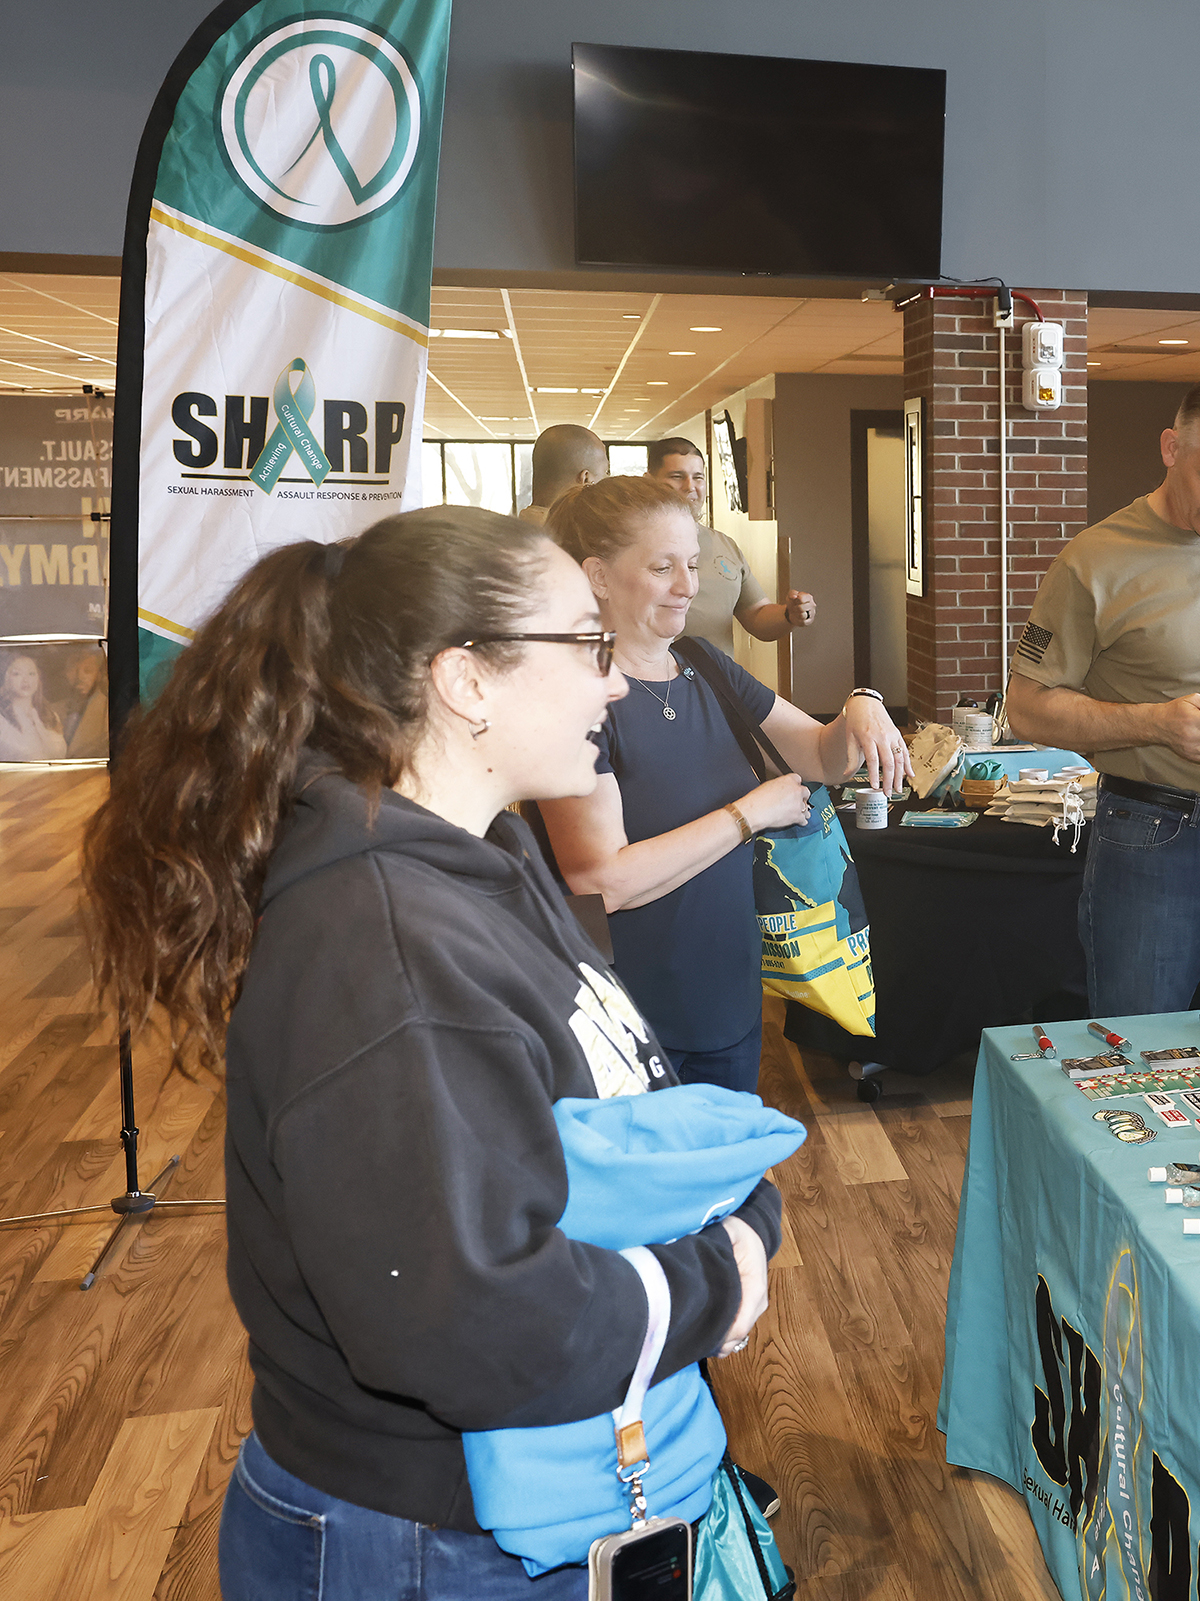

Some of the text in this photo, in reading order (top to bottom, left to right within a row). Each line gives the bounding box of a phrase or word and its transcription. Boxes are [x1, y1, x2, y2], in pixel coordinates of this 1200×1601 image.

[171, 380, 406, 482] SHARP
[281, 404, 323, 470] Cultural Change
[258, 441, 287, 482] Achieving
[167, 486, 254, 497] SEXUAL HARASSMENT
[277, 491, 315, 500] ASSAULT
[317, 492, 360, 501] RESPONSE
[368, 492, 402, 501] PREVENTION
[757, 914, 797, 933] PEOPLE
[1113, 1384, 1130, 1500] Cultural
